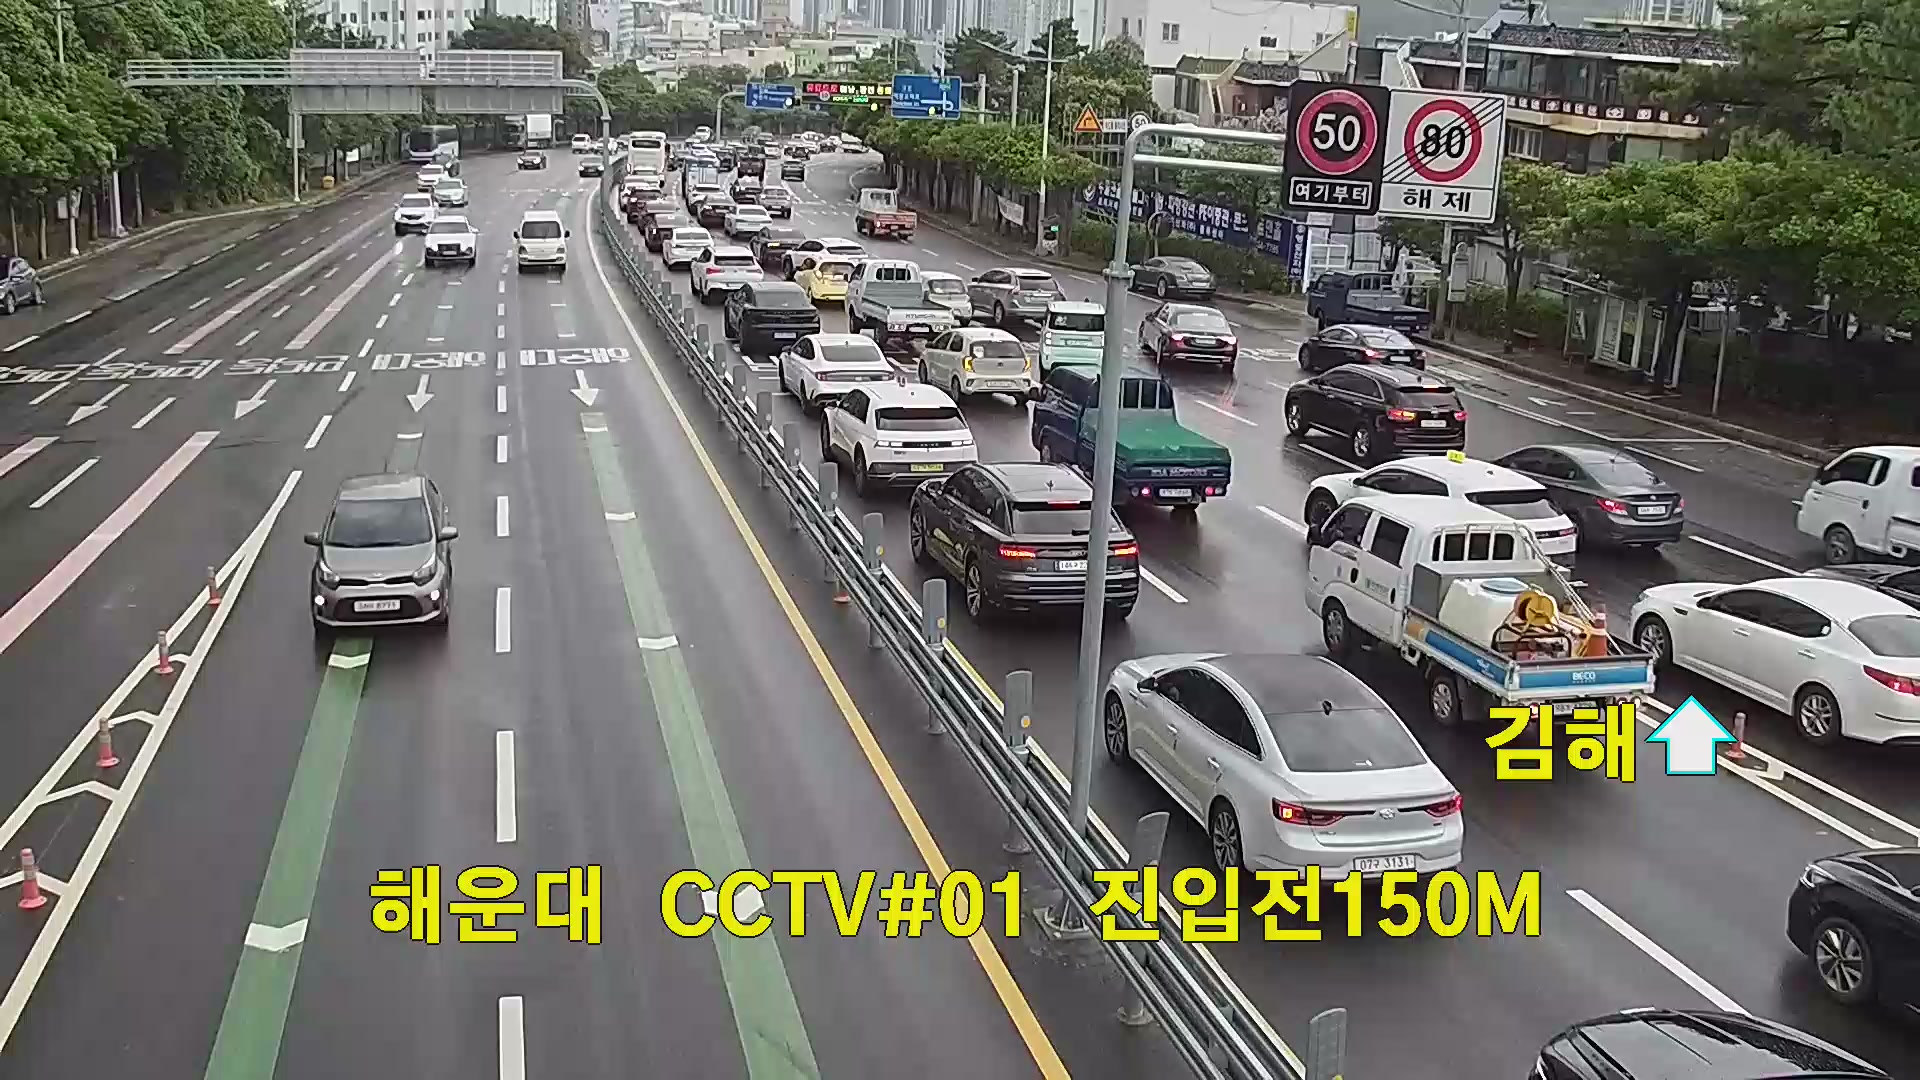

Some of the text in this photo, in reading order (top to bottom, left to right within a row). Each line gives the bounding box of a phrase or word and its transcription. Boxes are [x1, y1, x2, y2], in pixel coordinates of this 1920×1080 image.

[1313, 113, 1361, 152] 50
[1421, 123, 1467, 159] 80
[1294, 182, 1369, 205] 여기부터
[1402, 188, 1472, 213] 해제
[1384, 856, 1409, 869] 3131
